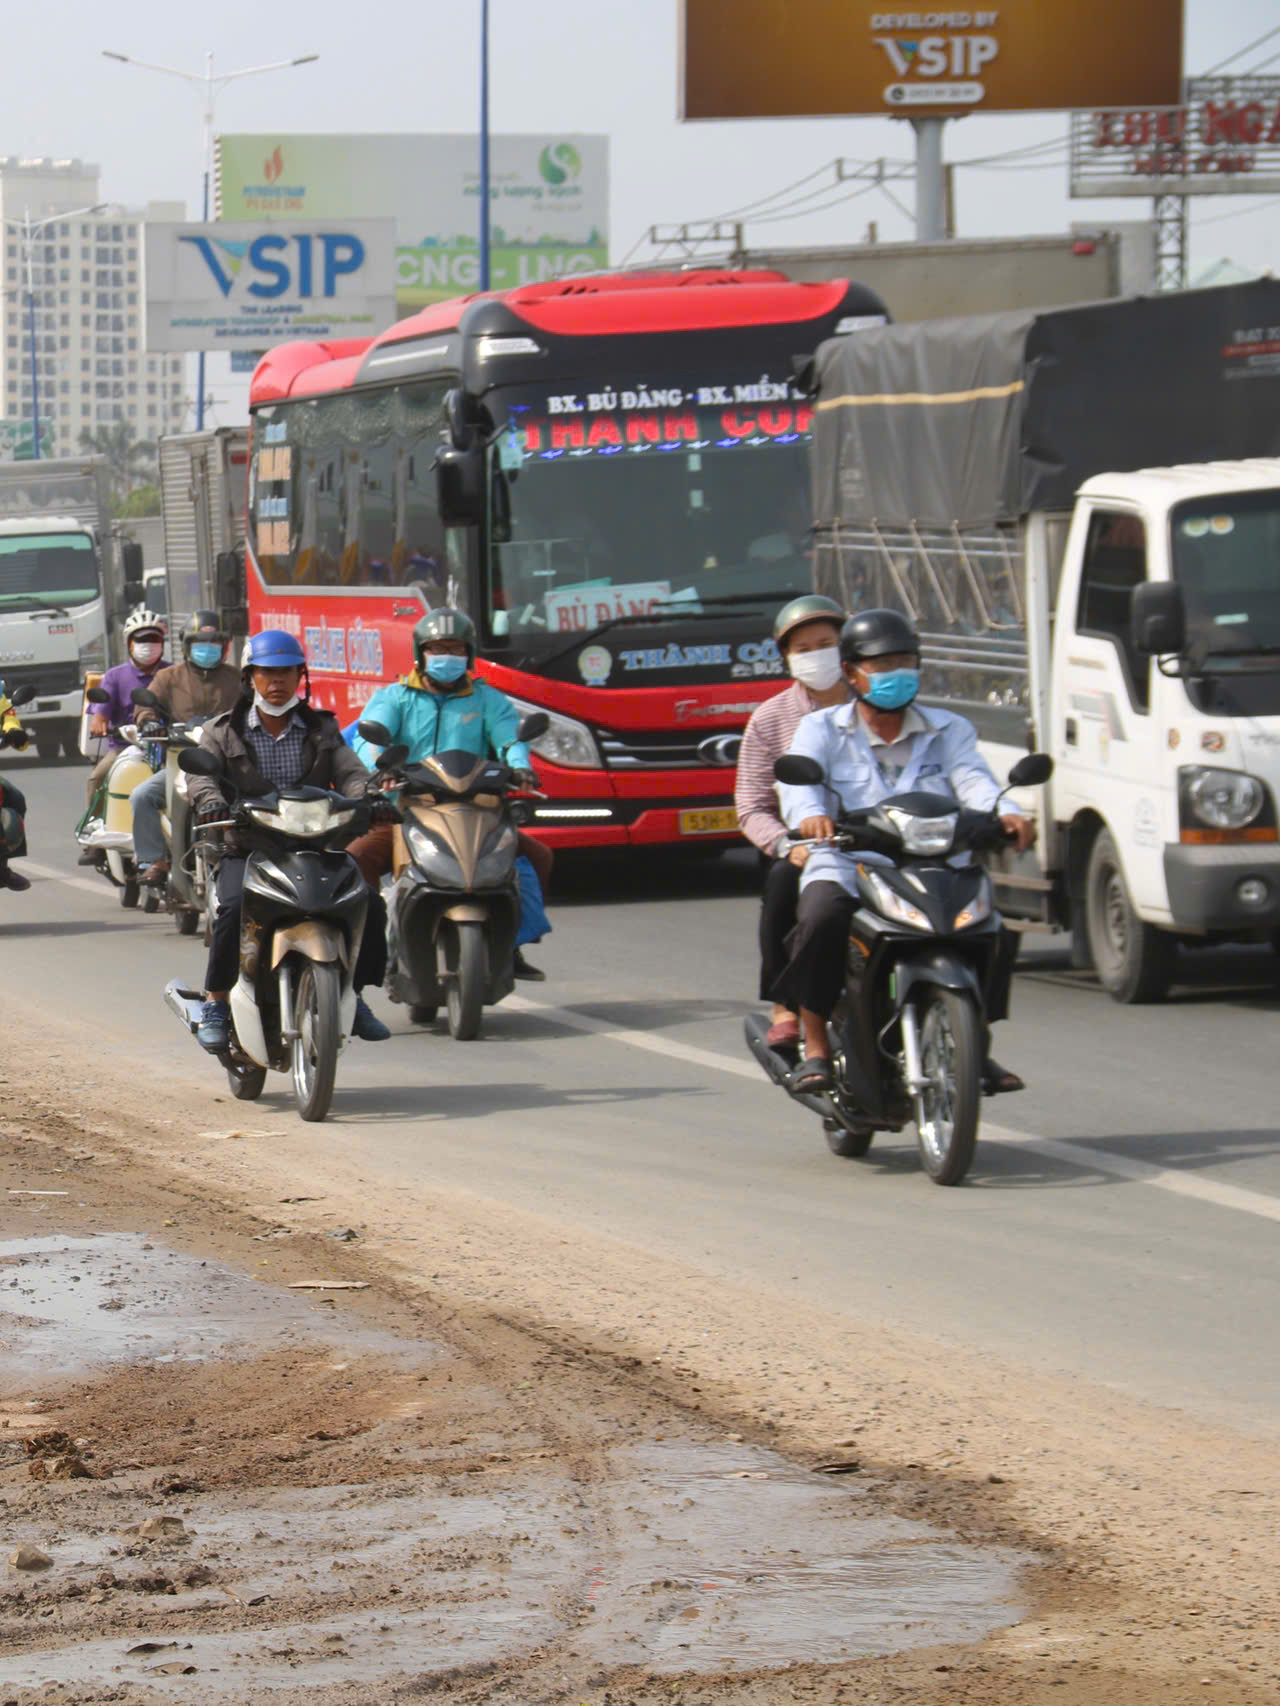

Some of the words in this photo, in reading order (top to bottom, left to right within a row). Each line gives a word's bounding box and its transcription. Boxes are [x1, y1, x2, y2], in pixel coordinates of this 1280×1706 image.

[871, 12, 970, 29] DEVELOPED
[975, 10, 998, 27] BY
[873, 35, 999, 77] VSIP
[178, 232, 367, 299] VSIP
[394, 253, 481, 287] CNG
[547, 395, 585, 414] BX.
[697, 386, 733, 405] BX.
[620, 642, 732, 670] THÀNH
[738, 637, 784, 663] CÔ
